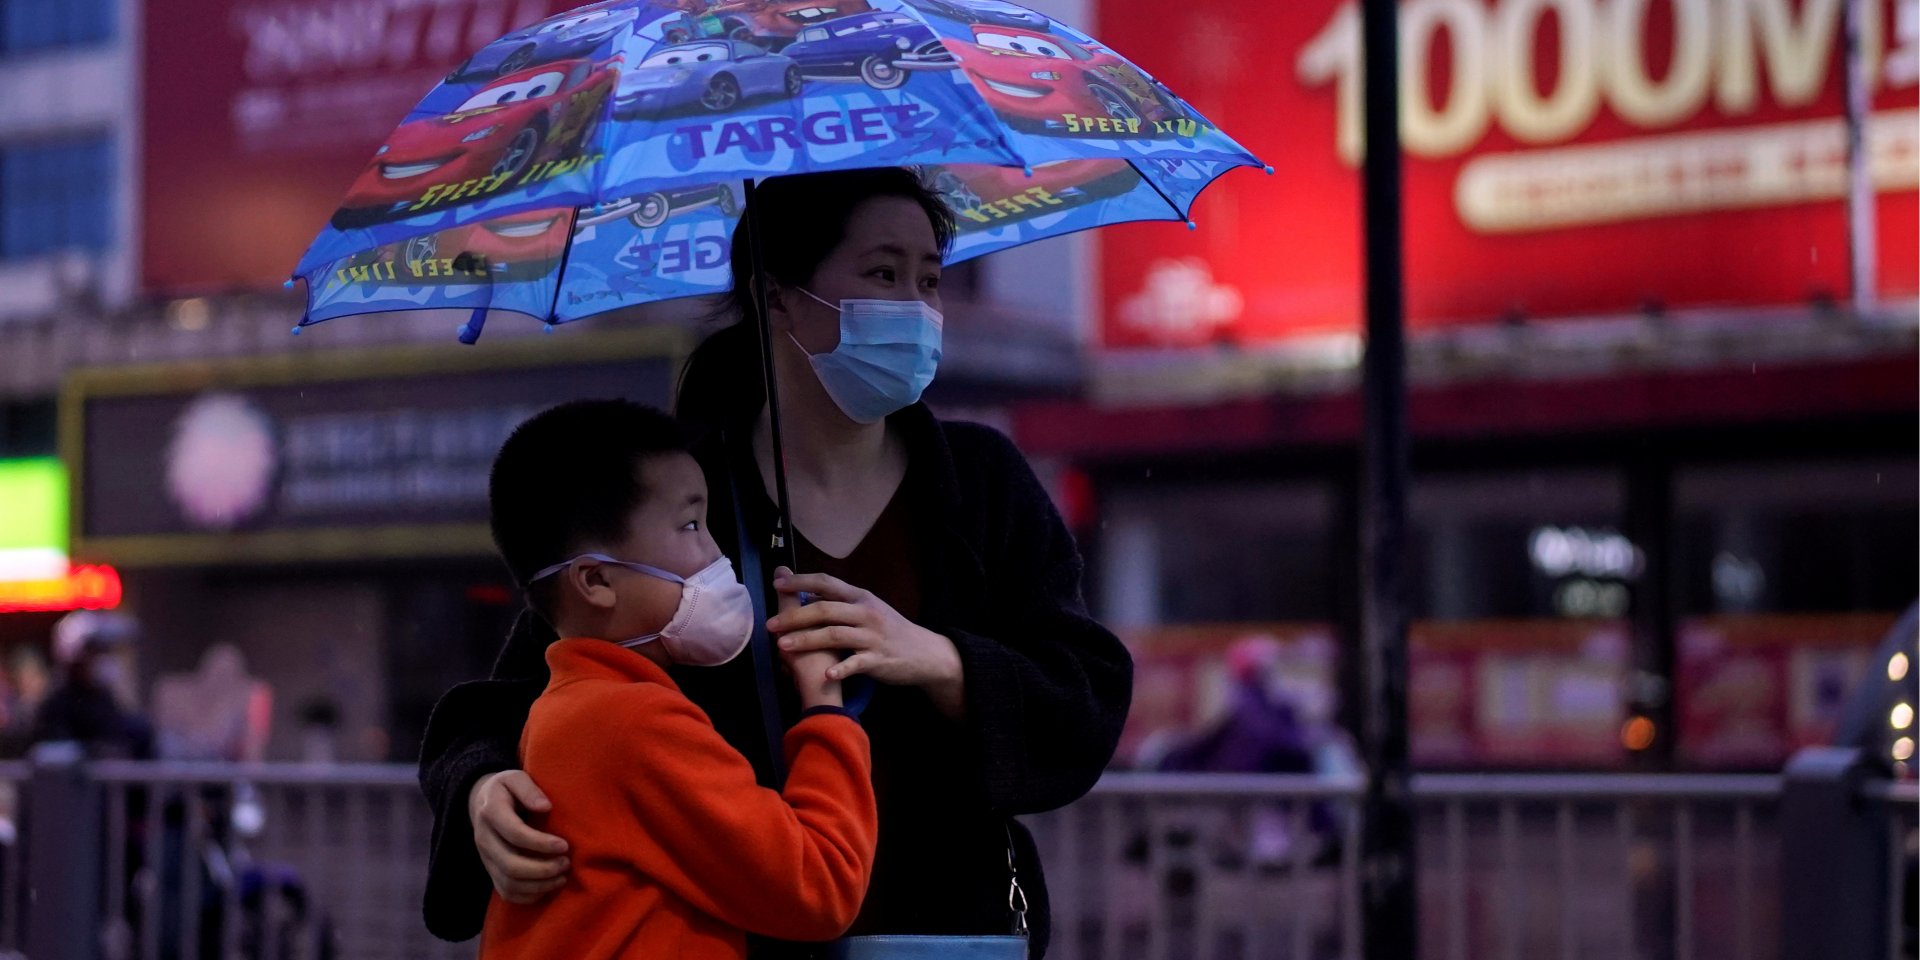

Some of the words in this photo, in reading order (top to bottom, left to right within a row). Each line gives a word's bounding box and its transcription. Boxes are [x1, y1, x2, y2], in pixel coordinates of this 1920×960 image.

[677, 104, 919, 159] TARGET
[1062, 114, 1139, 133] SPEED
[409, 171, 514, 211] SPEED
